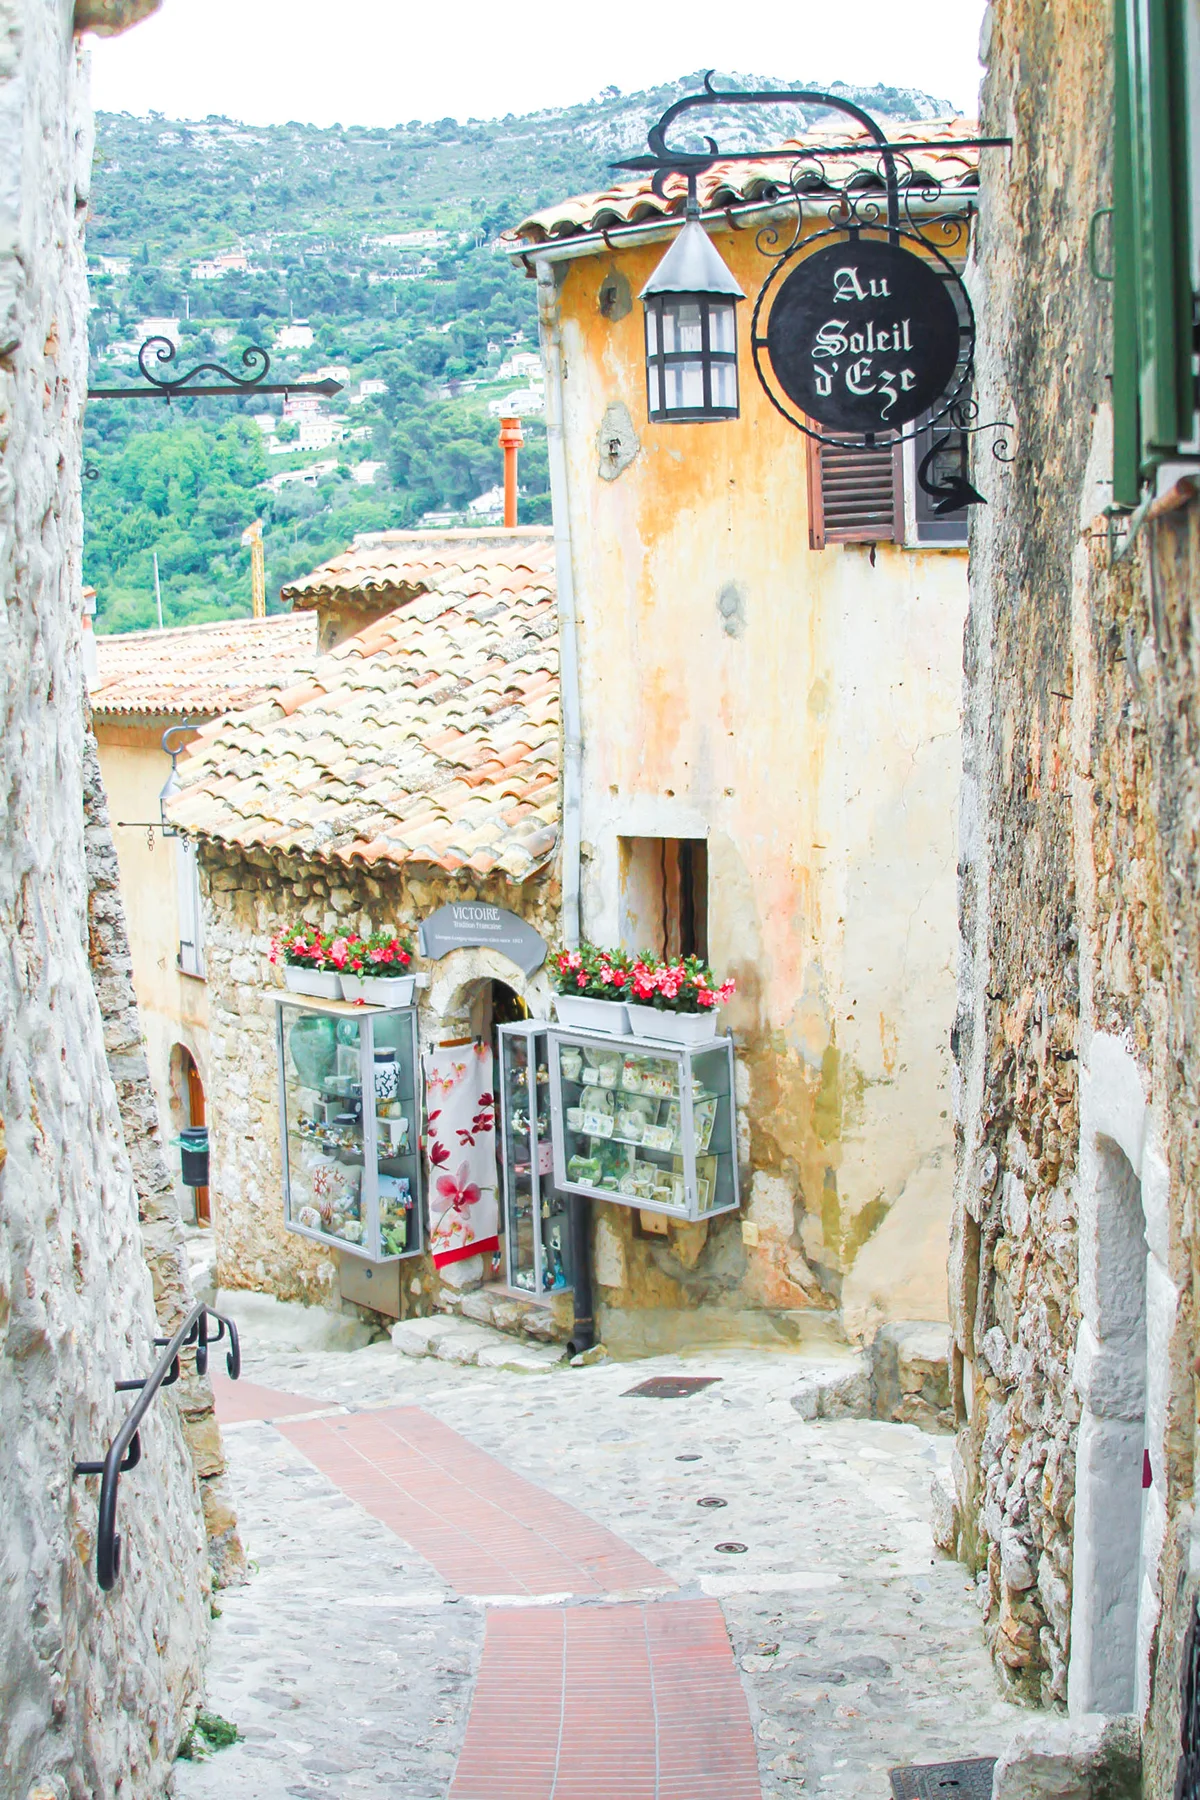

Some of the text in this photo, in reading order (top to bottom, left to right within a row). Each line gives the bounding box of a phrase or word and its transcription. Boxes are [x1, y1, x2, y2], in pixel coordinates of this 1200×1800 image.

[833, 266, 892, 303] Au
[811, 318, 914, 358] Soleil
[813, 357, 917, 420] d'Eze
[452, 906, 500, 921] VICTOIRE
